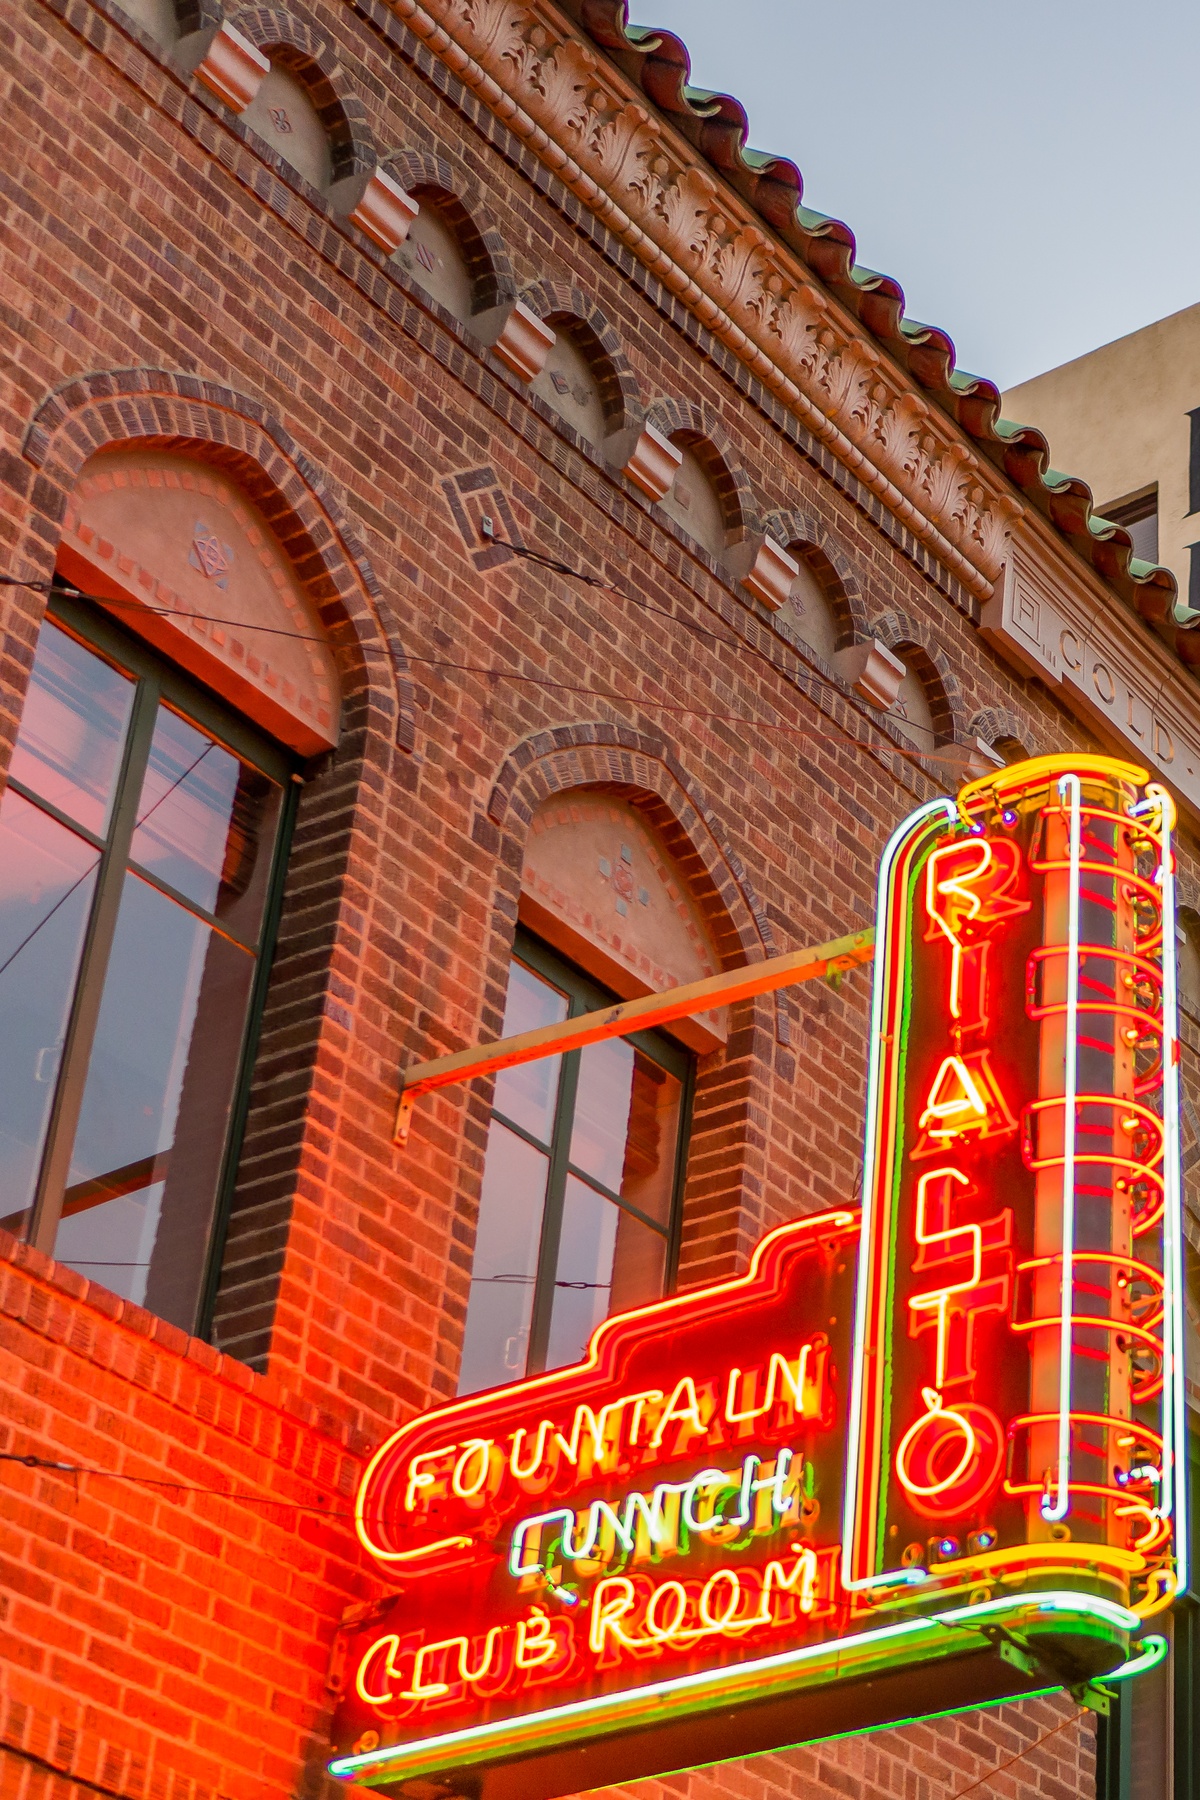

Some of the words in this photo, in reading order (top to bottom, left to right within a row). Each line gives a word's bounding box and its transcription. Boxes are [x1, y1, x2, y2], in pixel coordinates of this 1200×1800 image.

[1059, 628, 1175, 765] GOLD
[894, 835, 1026, 1516] RIALTO
[405, 1343, 830, 1513] FOUNTAIN
[508, 1447, 808, 1590] LUNCH
[356, 1606, 574, 1716] CLUB
[588, 1543, 838, 1673] ROOM
